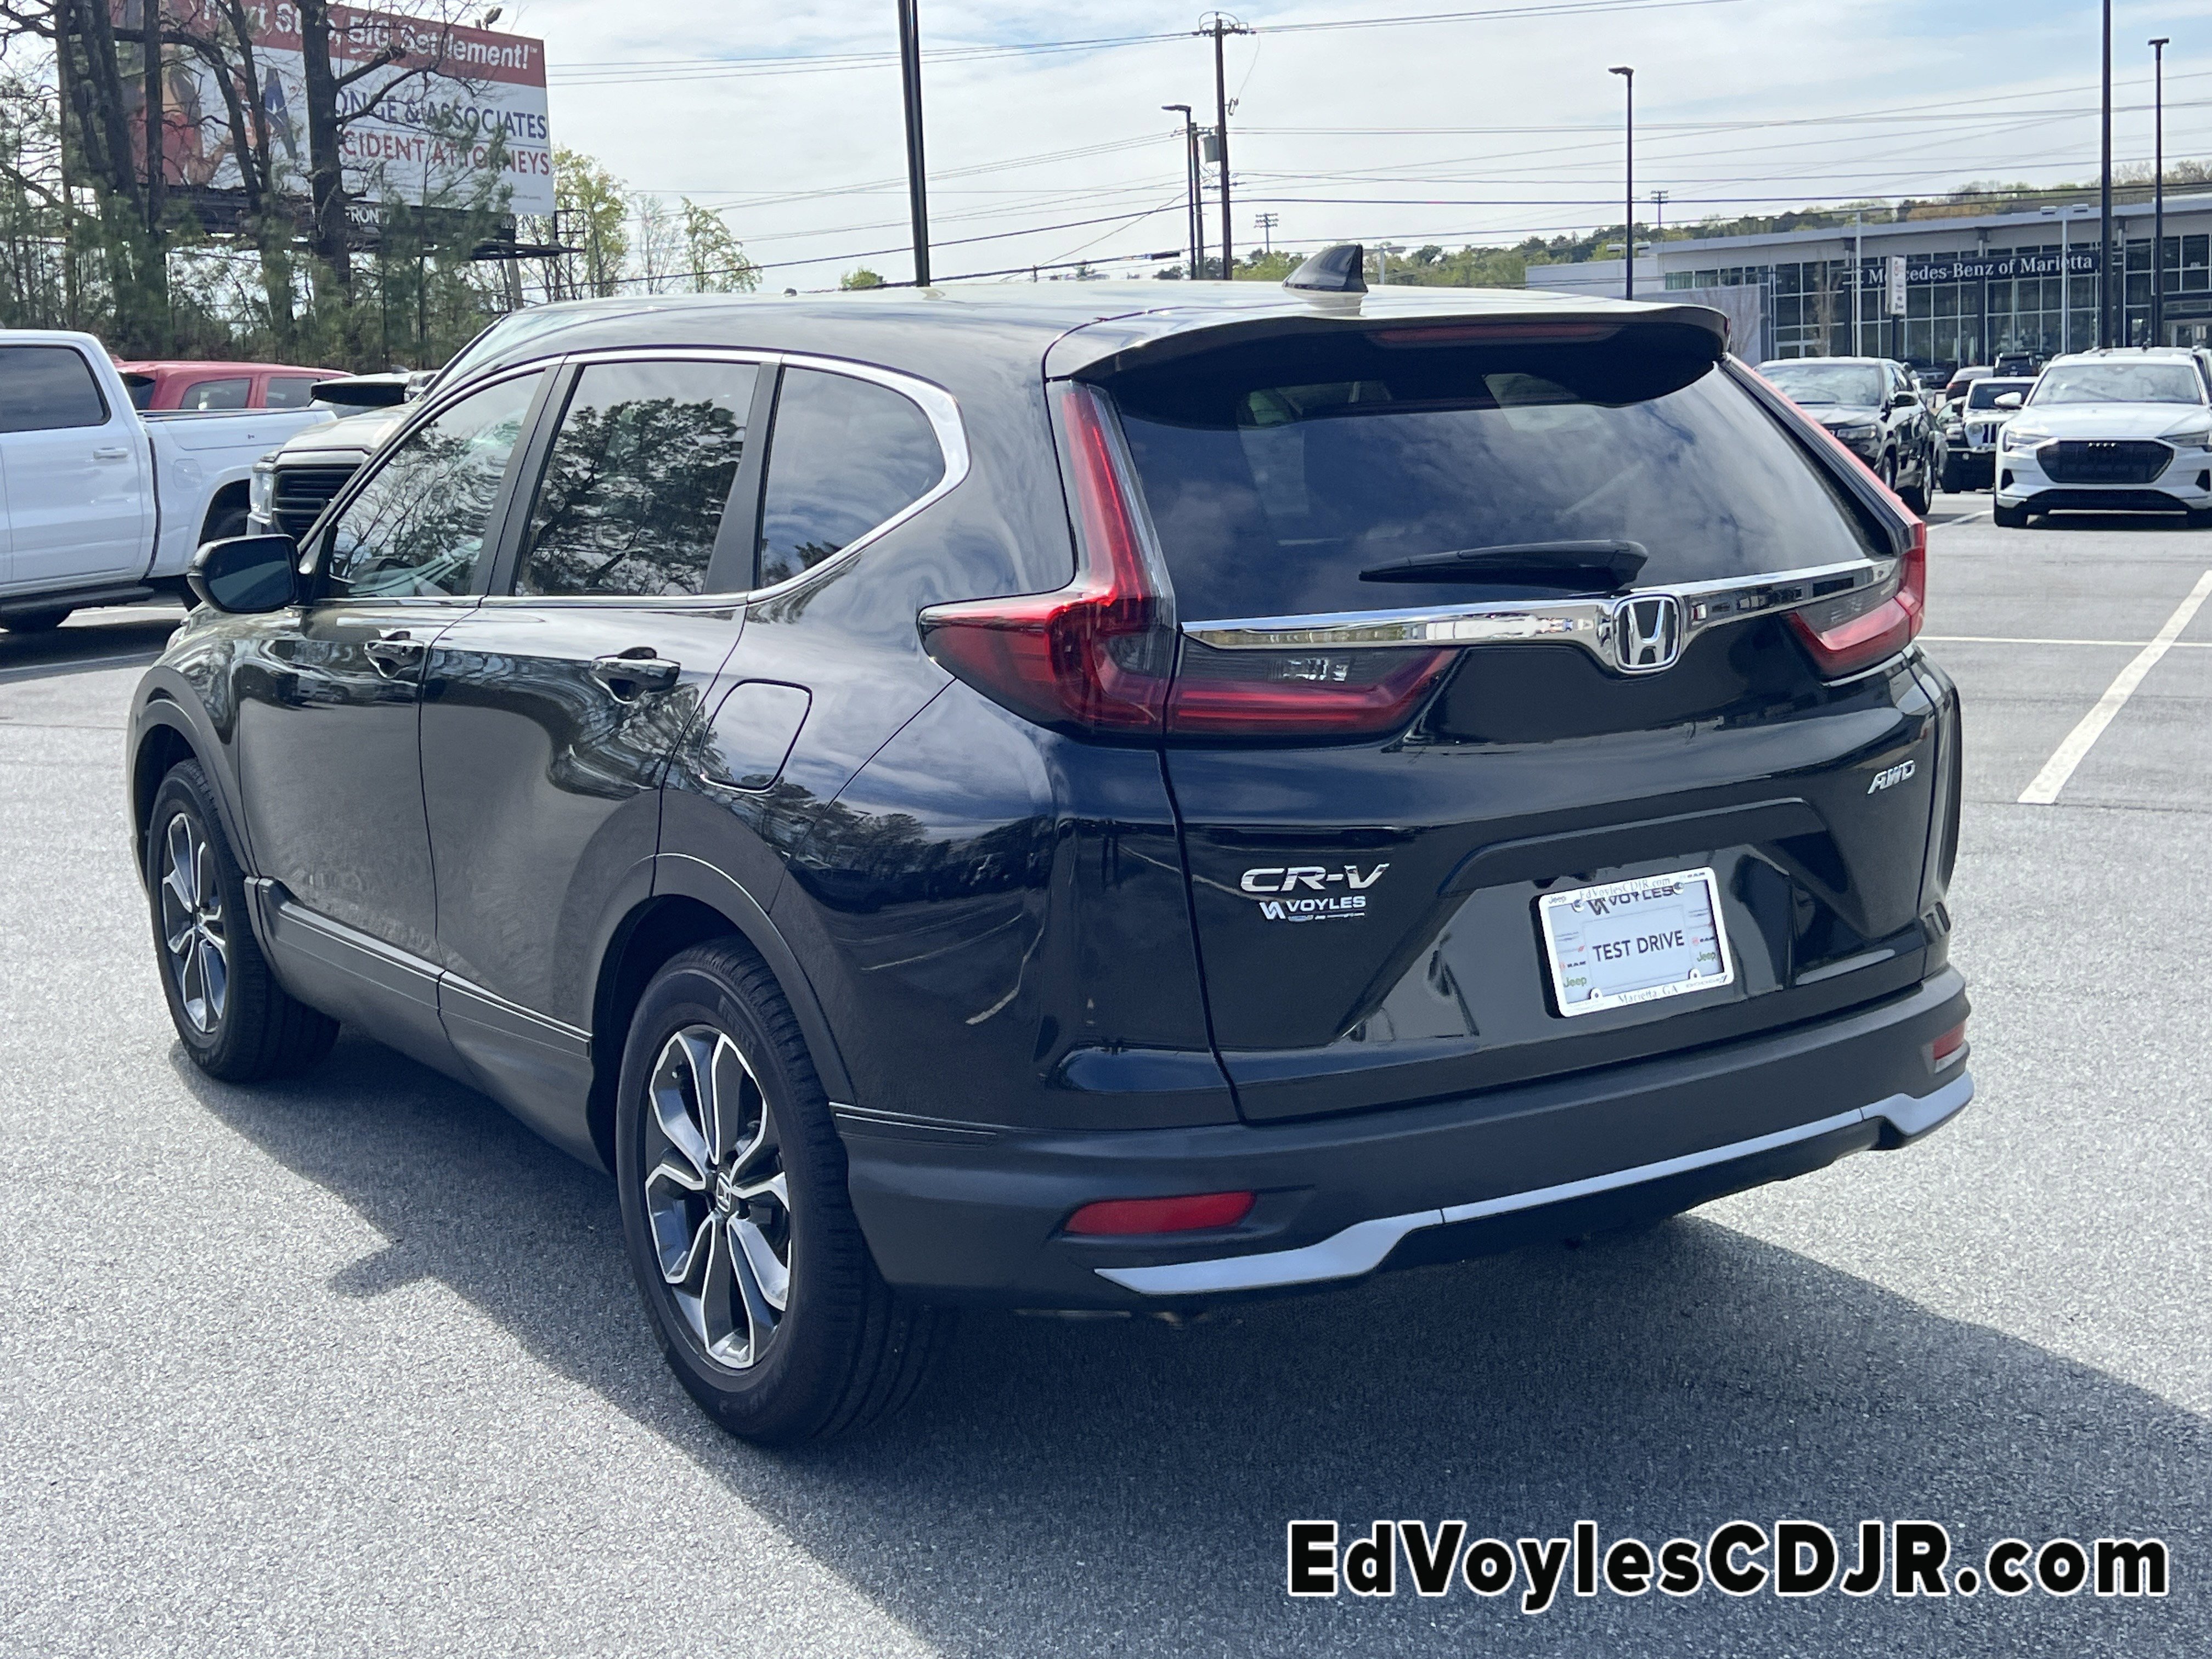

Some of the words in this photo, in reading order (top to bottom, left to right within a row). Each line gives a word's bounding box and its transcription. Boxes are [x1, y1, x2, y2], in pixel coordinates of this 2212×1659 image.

[341, 131, 425, 162] CIDENT
[432, 140, 549, 176] ATONEYS
[1869, 262, 1994, 283] Medes-Benz
[1998, 258, 2016, 275] of
[1867, 759, 1916, 794] AWD
[1240, 863, 1390, 892] CR-V
[1285, 895, 1367, 912] VOYLES
[1609, 885, 1674, 906] VOYLES
[1593, 940, 1631, 962] TEST
[1637, 930, 1685, 954] DRIVE
[1563, 977, 1587, 988] Jeep
